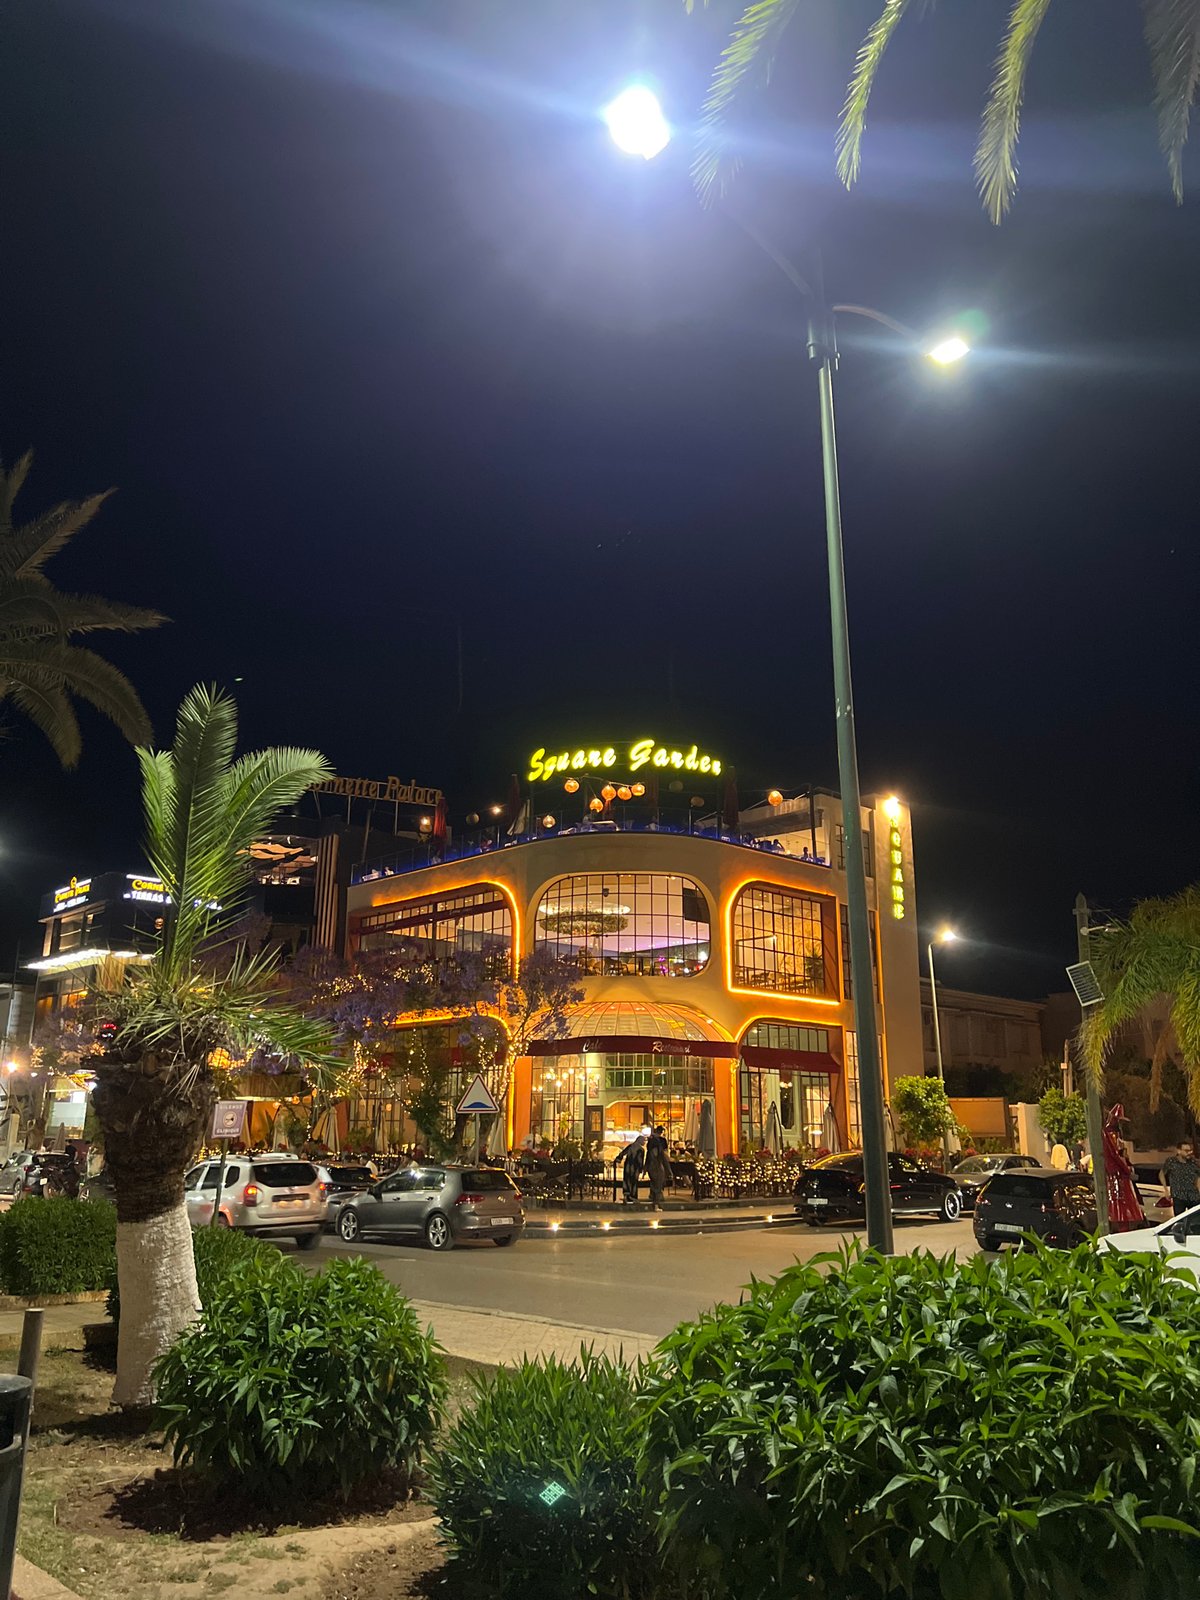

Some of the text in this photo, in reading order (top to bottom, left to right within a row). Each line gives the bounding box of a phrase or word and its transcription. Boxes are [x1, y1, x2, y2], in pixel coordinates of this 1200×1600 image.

[528, 739, 722, 781] Square Garden
[309, 775, 444, 804] ornette Palace
